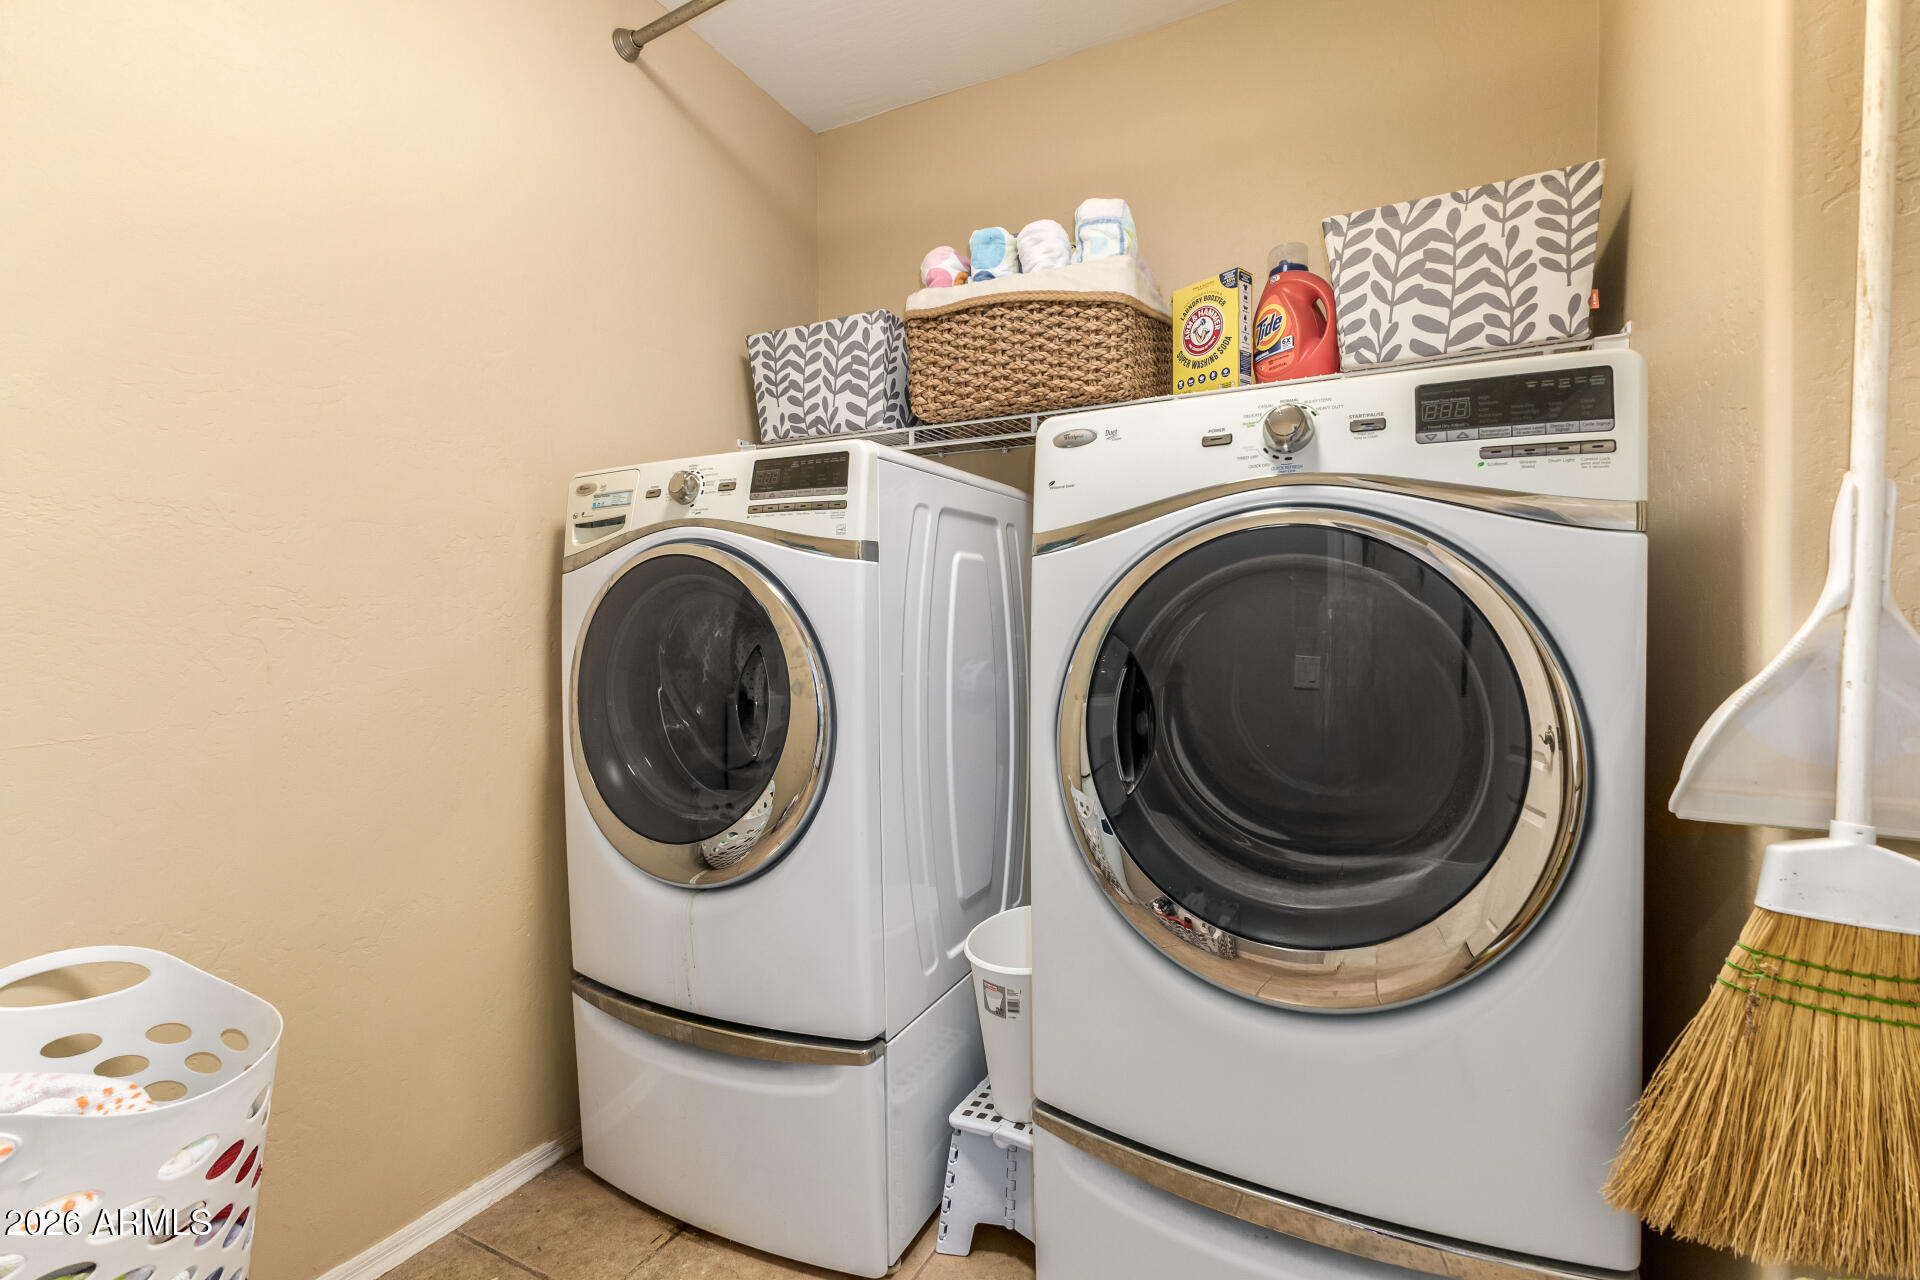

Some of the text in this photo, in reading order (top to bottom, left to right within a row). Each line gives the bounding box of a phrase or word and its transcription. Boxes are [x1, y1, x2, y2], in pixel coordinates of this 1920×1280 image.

[1180, 294, 1226, 321] LAUNDRY BOOSTER
[1184, 320, 1194, 341] ARM
[1198, 308, 1221, 331] HAMMER
[1256, 311, 1283, 347] Tide
[1282, 337, 1291, 345] 6X
[1176, 351, 1191, 369] SUPER
[1191, 353, 1219, 370] WASHING
[1217, 336, 1233, 355] SODA
